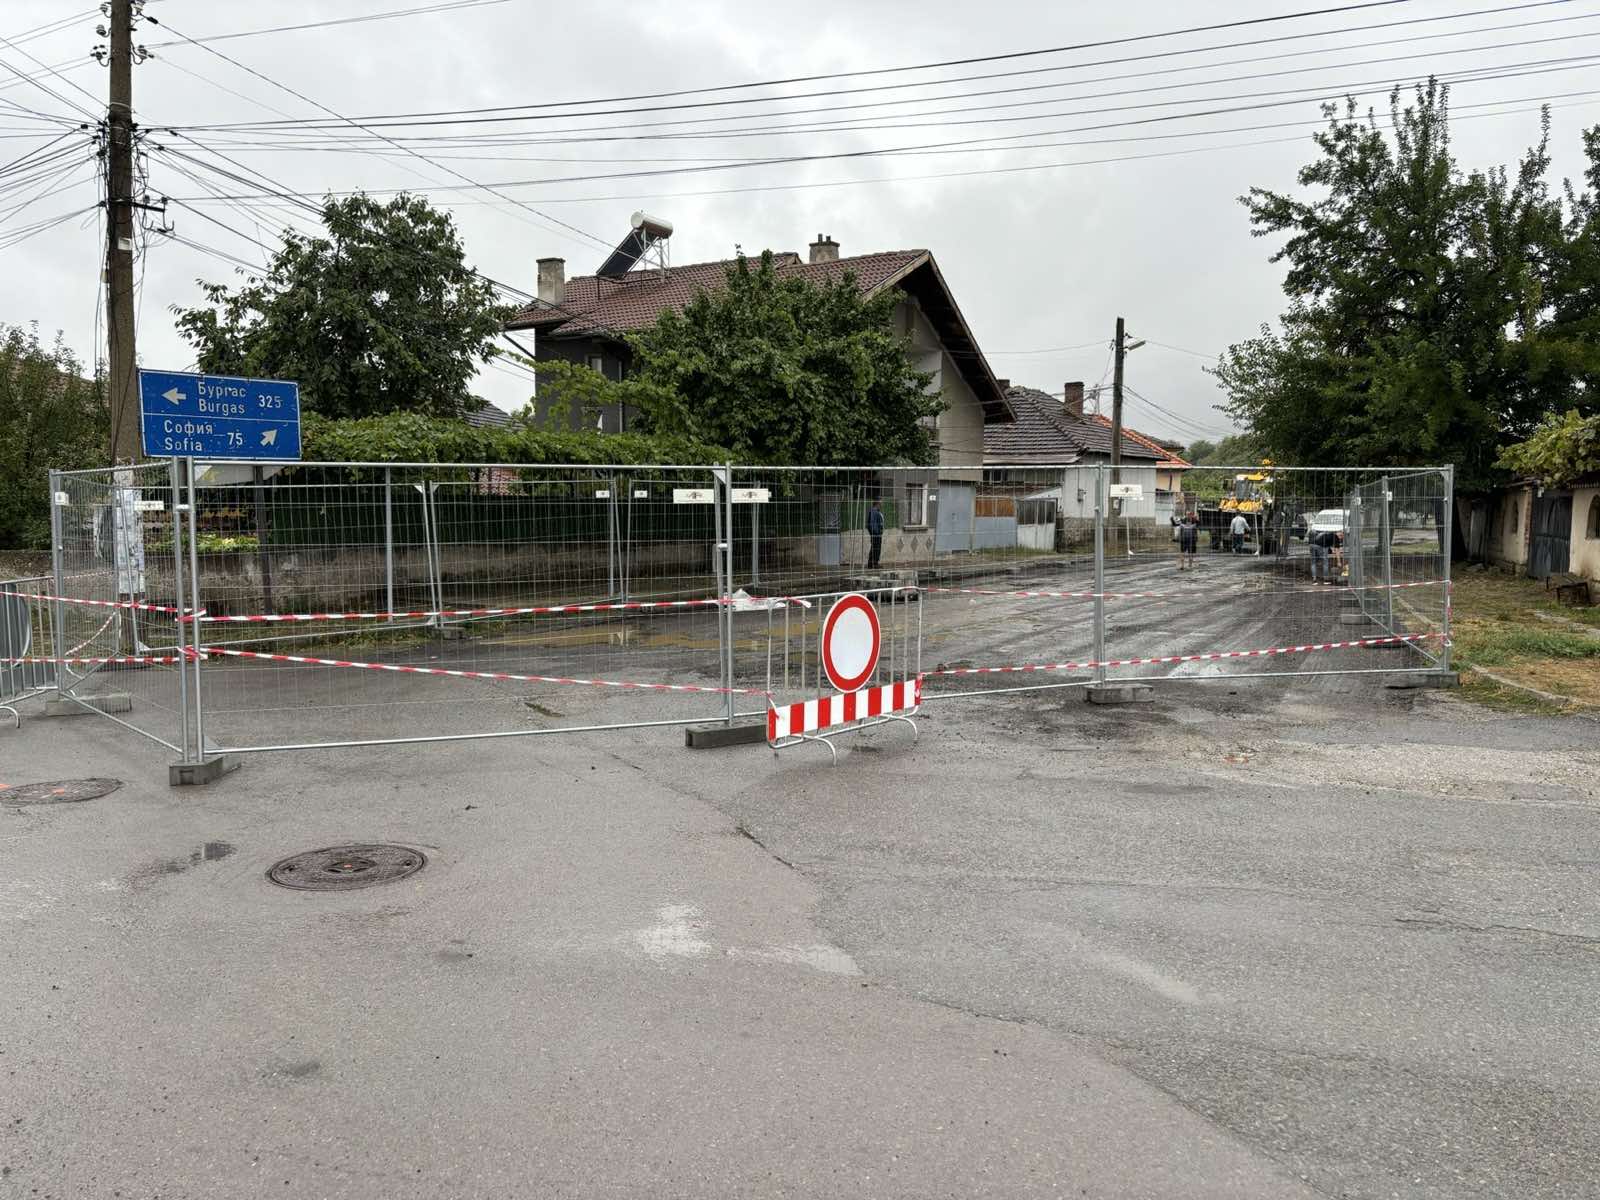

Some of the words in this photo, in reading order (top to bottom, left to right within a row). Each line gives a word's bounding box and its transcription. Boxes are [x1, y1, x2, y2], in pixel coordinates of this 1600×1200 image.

[198, 381, 247, 399] Бургас
[199, 399, 246, 416] Burgas
[258, 394, 282, 409] 325
[164, 419, 214, 437] София
[164, 437, 203, 451] Sofia
[227, 432, 243, 446] 75
